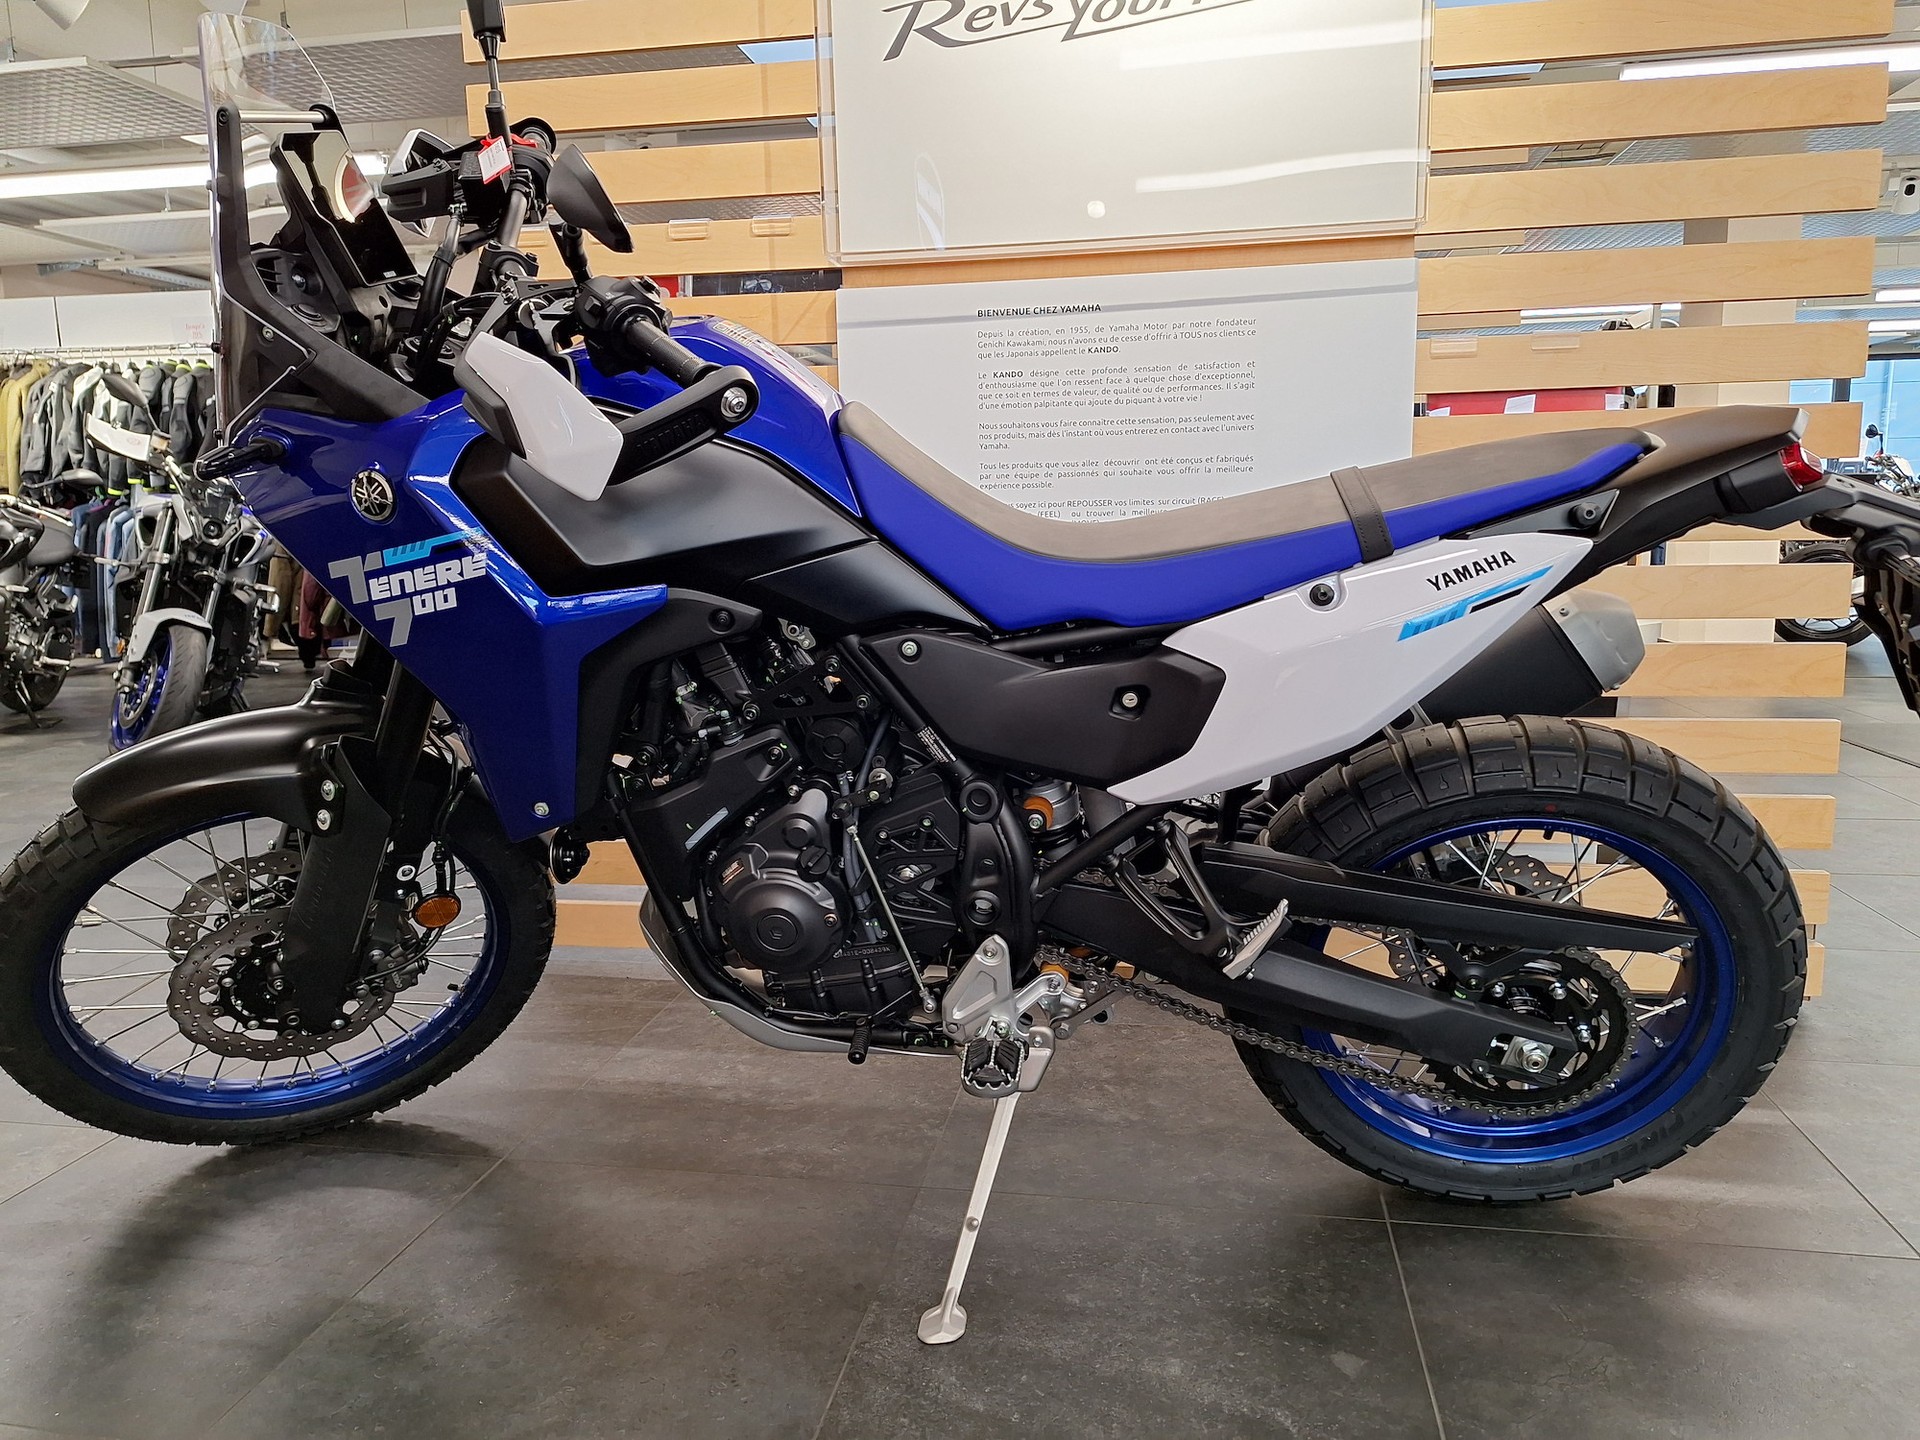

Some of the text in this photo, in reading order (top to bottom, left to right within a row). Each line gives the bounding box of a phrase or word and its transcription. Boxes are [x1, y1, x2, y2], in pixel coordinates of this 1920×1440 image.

[977, 304, 1102, 317] BIENVENUE CHEZ YAMAHA
[977, 330, 1004, 341] Depuis
[1008, 329, 1014, 337] la
[1070, 326, 1090, 336] 1955,
[1094, 325, 1104, 333] de
[1109, 324, 1139, 332] Yamaha
[1172, 323, 1185, 331] par
[1190, 321, 1212, 329] notre
[1216, 319, 1256, 327] fondateur
[977, 339, 1005, 348] Genichi
[1006, 339, 1046, 347] Kawakami,
[1109, 333, 1120, 342] de
[1120, 334, 1142, 342] cesse
[1180, 330, 1202, 339] TOUS
[1219, 328, 1245, 337] clients
[977, 351, 992, 360] que
[994, 349, 1004, 358] les
[1006, 347, 1039, 358] Japonais
[1040, 346, 1076, 357] appellent
[1078, 345, 1086, 354] le
[1030, 370, 1059, 379] désigne
[1065, 368, 1086, 376] cette
[1092, 366, 1128, 377] profonde
[1134, 365, 1171, 373] sensation
[1178, 363, 1188, 371] de
[1194, 361, 1240, 370] satisfaction
[1040, 379, 1054, 389] que
[1074, 377, 1103, 385] ressent
[1106, 375, 1122, 384] face
[1133, 373, 1165, 385] quelque
[1168, 372, 1191, 382] chose
[978, 392, 992, 401] que
[1005, 389, 1019, 398] soit
[1021, 390, 1031, 398] en
[1033, 388, 1060, 397] termes
[1062, 387, 1072, 396] de
[1073, 386, 1099, 398] valeur,
[1101, 386, 1111, 395] de
[1113, 385, 1140, 396] qualité
[1154, 384, 1165, 393] de
[1167, 382, 1223, 394] performances.
[1226, 381, 1231, 389] Il
[1000, 399, 1032, 408] émotion
[1034, 397, 1073, 409] palpitante
[1074, 397, 1086, 407] qui
[1088, 396, 1112, 407] ajoute
[1114, 395, 1124, 404] du
[1126, 394, 1155, 405] piquant
[1163, 393, 1185, 402] votre
[1186, 393, 1198, 401] vie
[999, 421, 1040, 429] souhaitons
[1060, 419, 1077, 427] faire
[1138, 416, 1177, 426] sensation,
[1178, 417, 1192, 425] pas
[1194, 414, 1235, 422] seulement
[978, 432, 992, 440] nos
[994, 430, 1026, 441] produits,
[1028, 429, 1046, 438] mais
[1124, 425, 1158, 435] entrerez
[1170, 424, 1200, 433] contact
[978, 440, 1010, 449] Yamaha.
[1012, 461, 1043, 471] produits
[1160, 457, 1174, 465] été
[1216, 455, 1254, 465] fabriqués
[979, 472, 992, 481] par
[1014, 469, 1040, 480] équipe
[1044, 469, 1053, 477] de
[1058, 467, 1099, 479] passionnés
[1103, 467, 1116, 477] qui
[1120, 466, 1152, 476] souhaite
[1179, 465, 1200, 474] offrir
[1204, 465, 1212, 473] la
[1216, 464, 1254, 473] meilleure
[979, 480, 1054, 490] expérience possible.
[1048, 502, 1065, 510] pour
[1086, 508, 1114, 516] trouver
[1120, 507, 1126, 516] la
[1426, 550, 1517, 592] YAMAHA
[373, 587, 458, 647] 700
